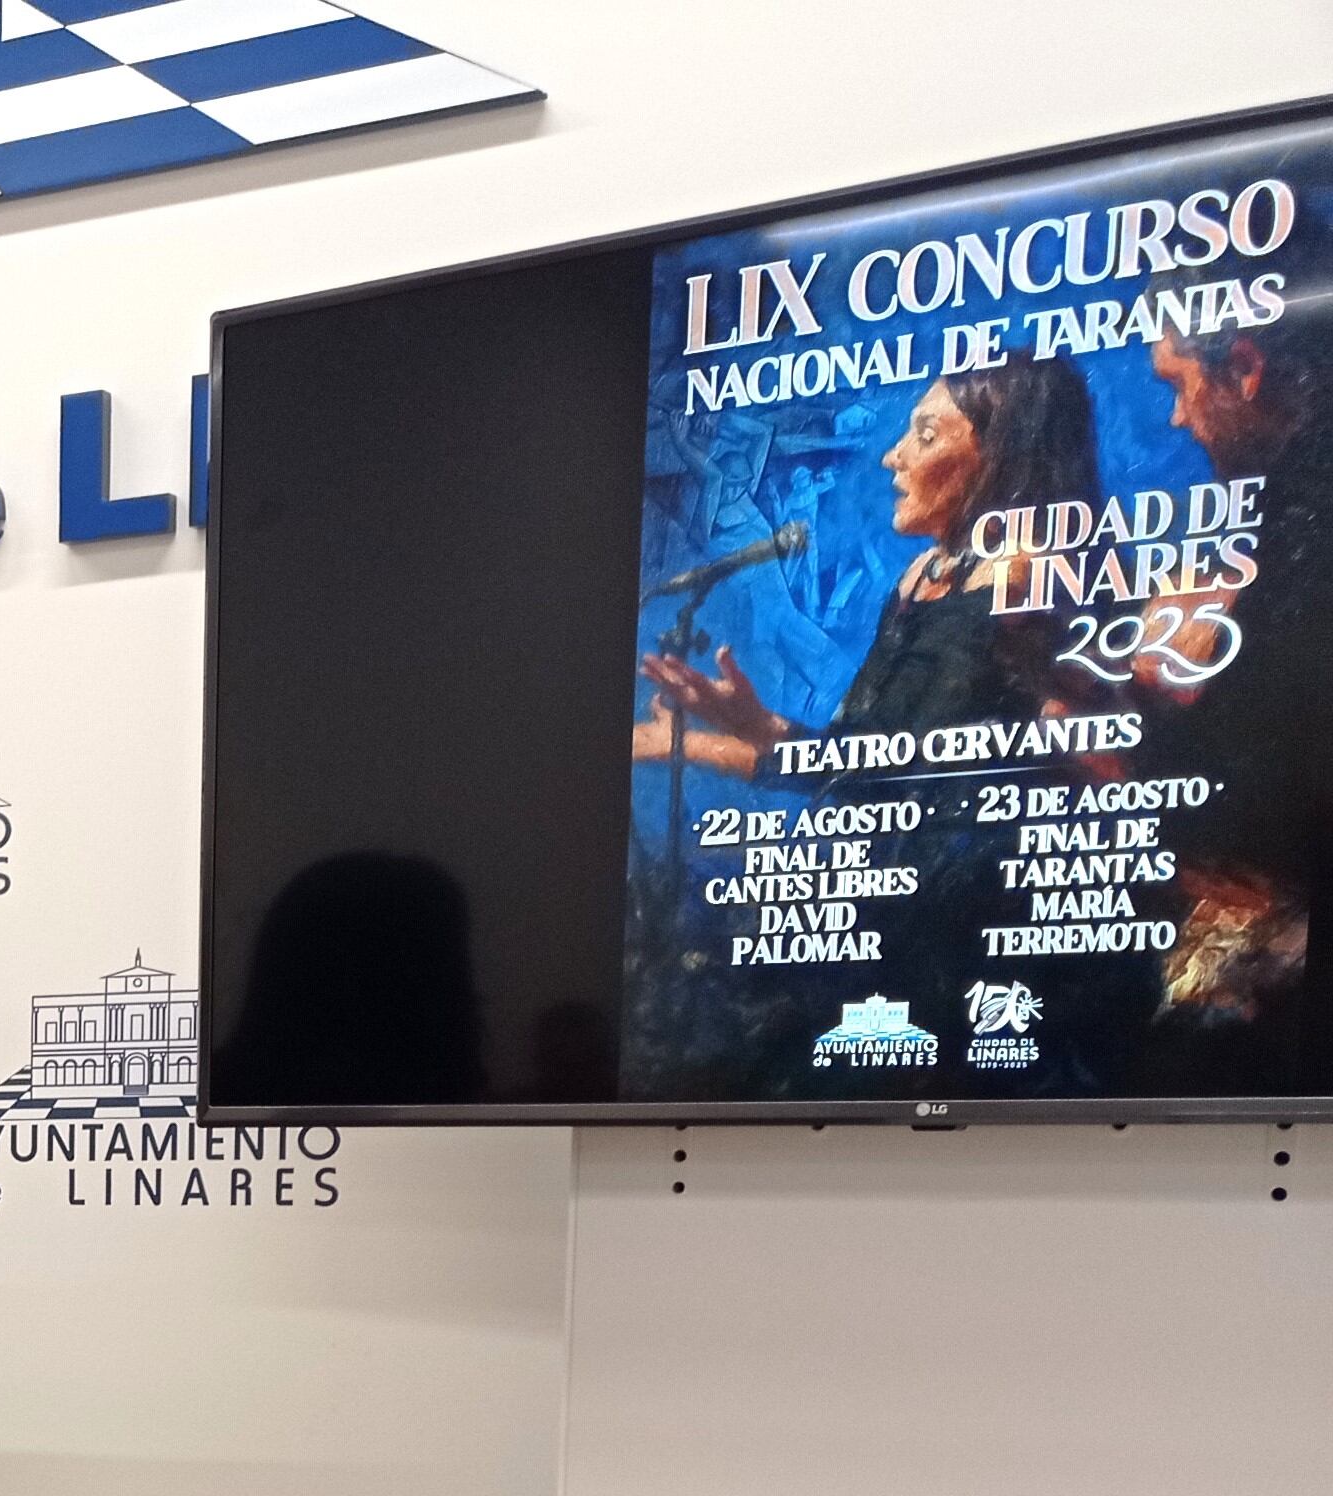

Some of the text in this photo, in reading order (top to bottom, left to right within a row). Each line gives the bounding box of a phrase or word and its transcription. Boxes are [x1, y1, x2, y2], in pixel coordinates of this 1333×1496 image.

[685, 179, 1296, 355] LIX CONCURSO
[685, 274, 1286, 414] NACIONAL DE TARANTAS
[970, 476, 1266, 559] CIUDAD DE
[989, 534, 1259, 616] LINARES
[1055, 602, 1244, 686] 2025
[774, 712, 1143, 775] TEATRO CERVANTES
[1027, 786, 1069, 818] DE
[1074, 777, 1209, 814] AGOSTO
[745, 811, 786, 842] DE
[1019, 817, 1160, 854] FINAL DE
[744, 839, 871, 874] FINAL DE
[1000, 852, 1177, 889] TARANTAS
[704, 867, 918, 903] CANTES LIBRES
[759, 902, 857, 934] DAVID
[1031, 887, 1135, 921] MARÍA
[731, 932, 882, 965] PALOMAR
[982, 921, 1177, 957] TERREMOTO
[813, 1039, 939, 1054] AYUNTAMIENTO
[813, 1053, 938, 1067] de LINARES
[967, 1047, 1039, 1061] LINARES
[931, 1104, 947, 1115] LG
[68, 1167, 340, 1207] LINARES
